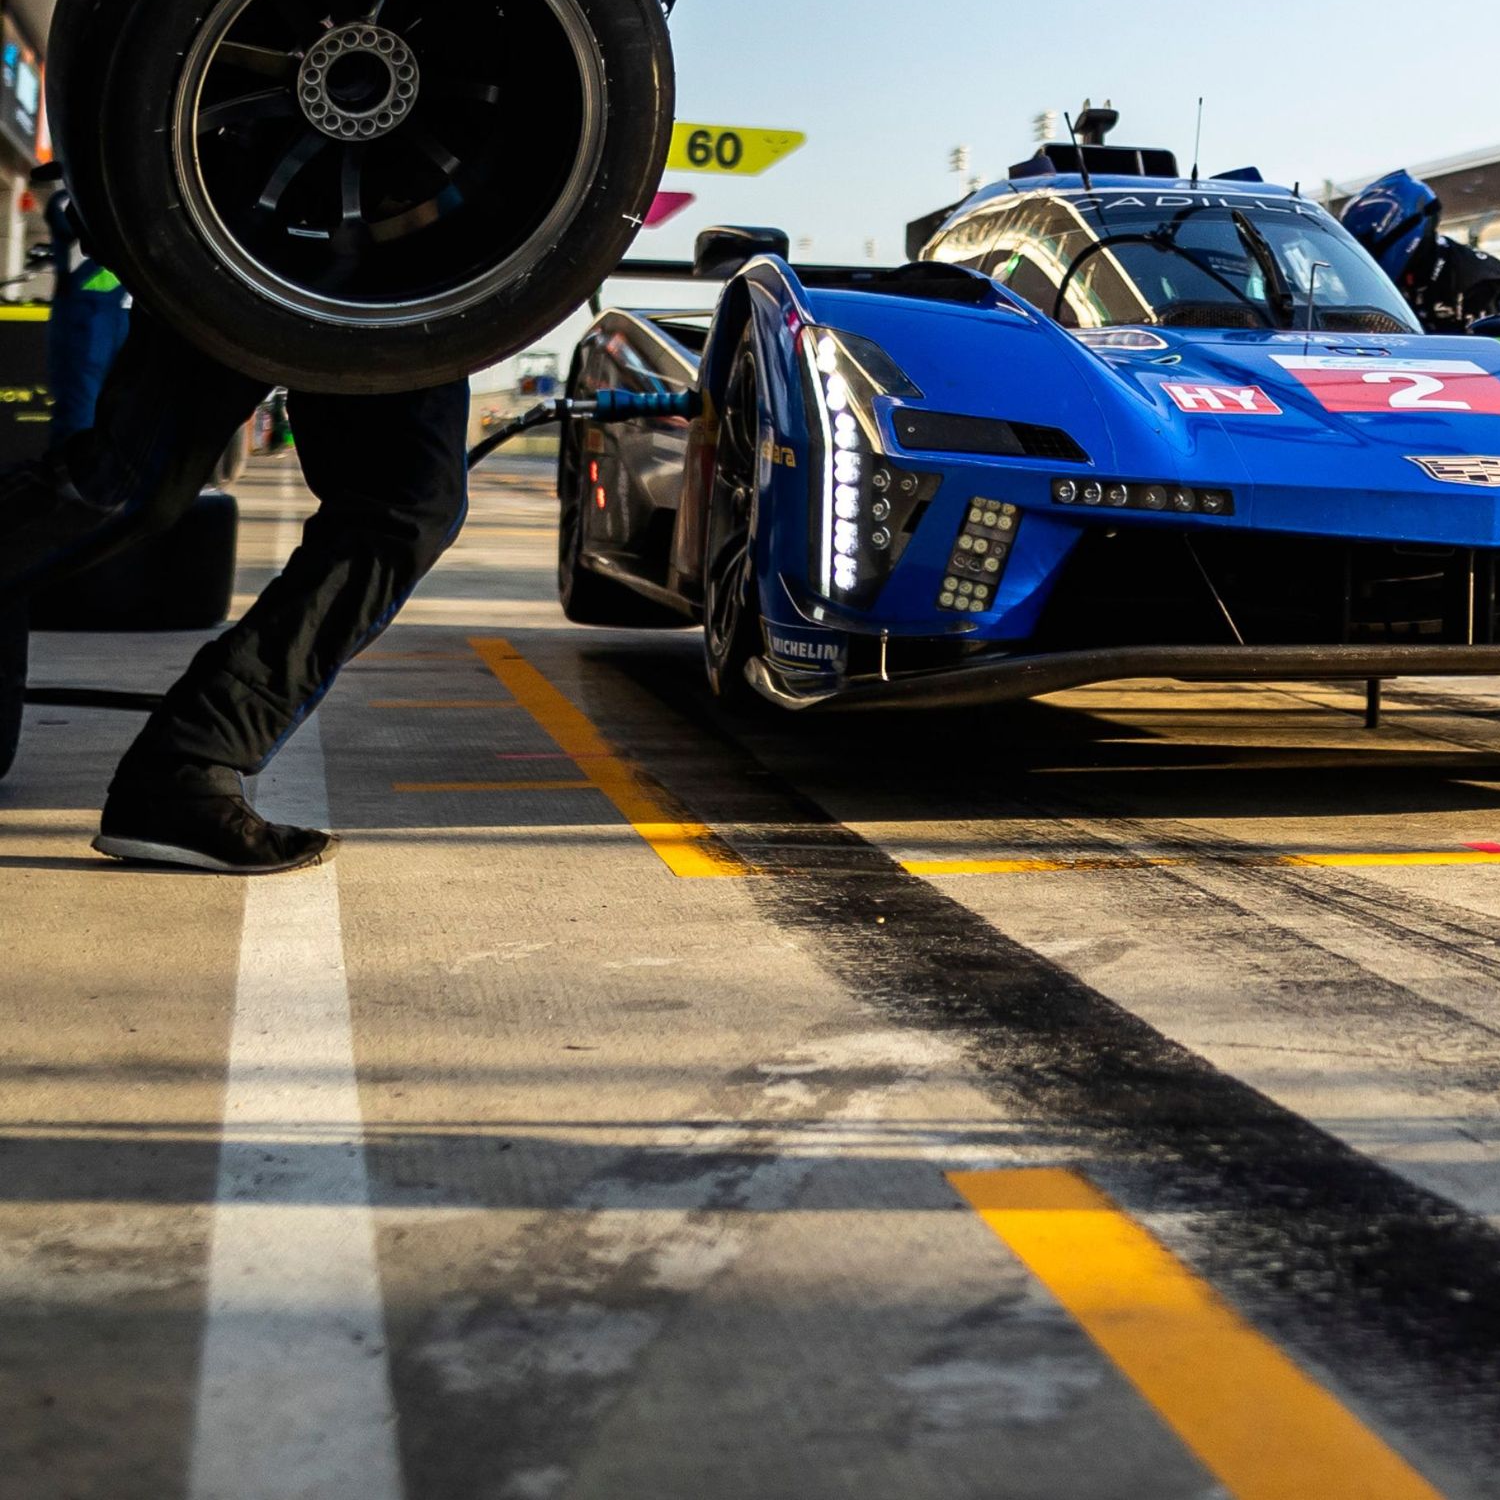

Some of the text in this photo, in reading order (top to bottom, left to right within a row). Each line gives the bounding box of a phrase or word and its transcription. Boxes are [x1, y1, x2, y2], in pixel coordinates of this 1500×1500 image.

[686, 129, 744, 170] 60
[1170, 385, 1258, 411] HY
[1362, 372, 1472, 410] 2
[772, 636, 839, 660] MICHELIN
